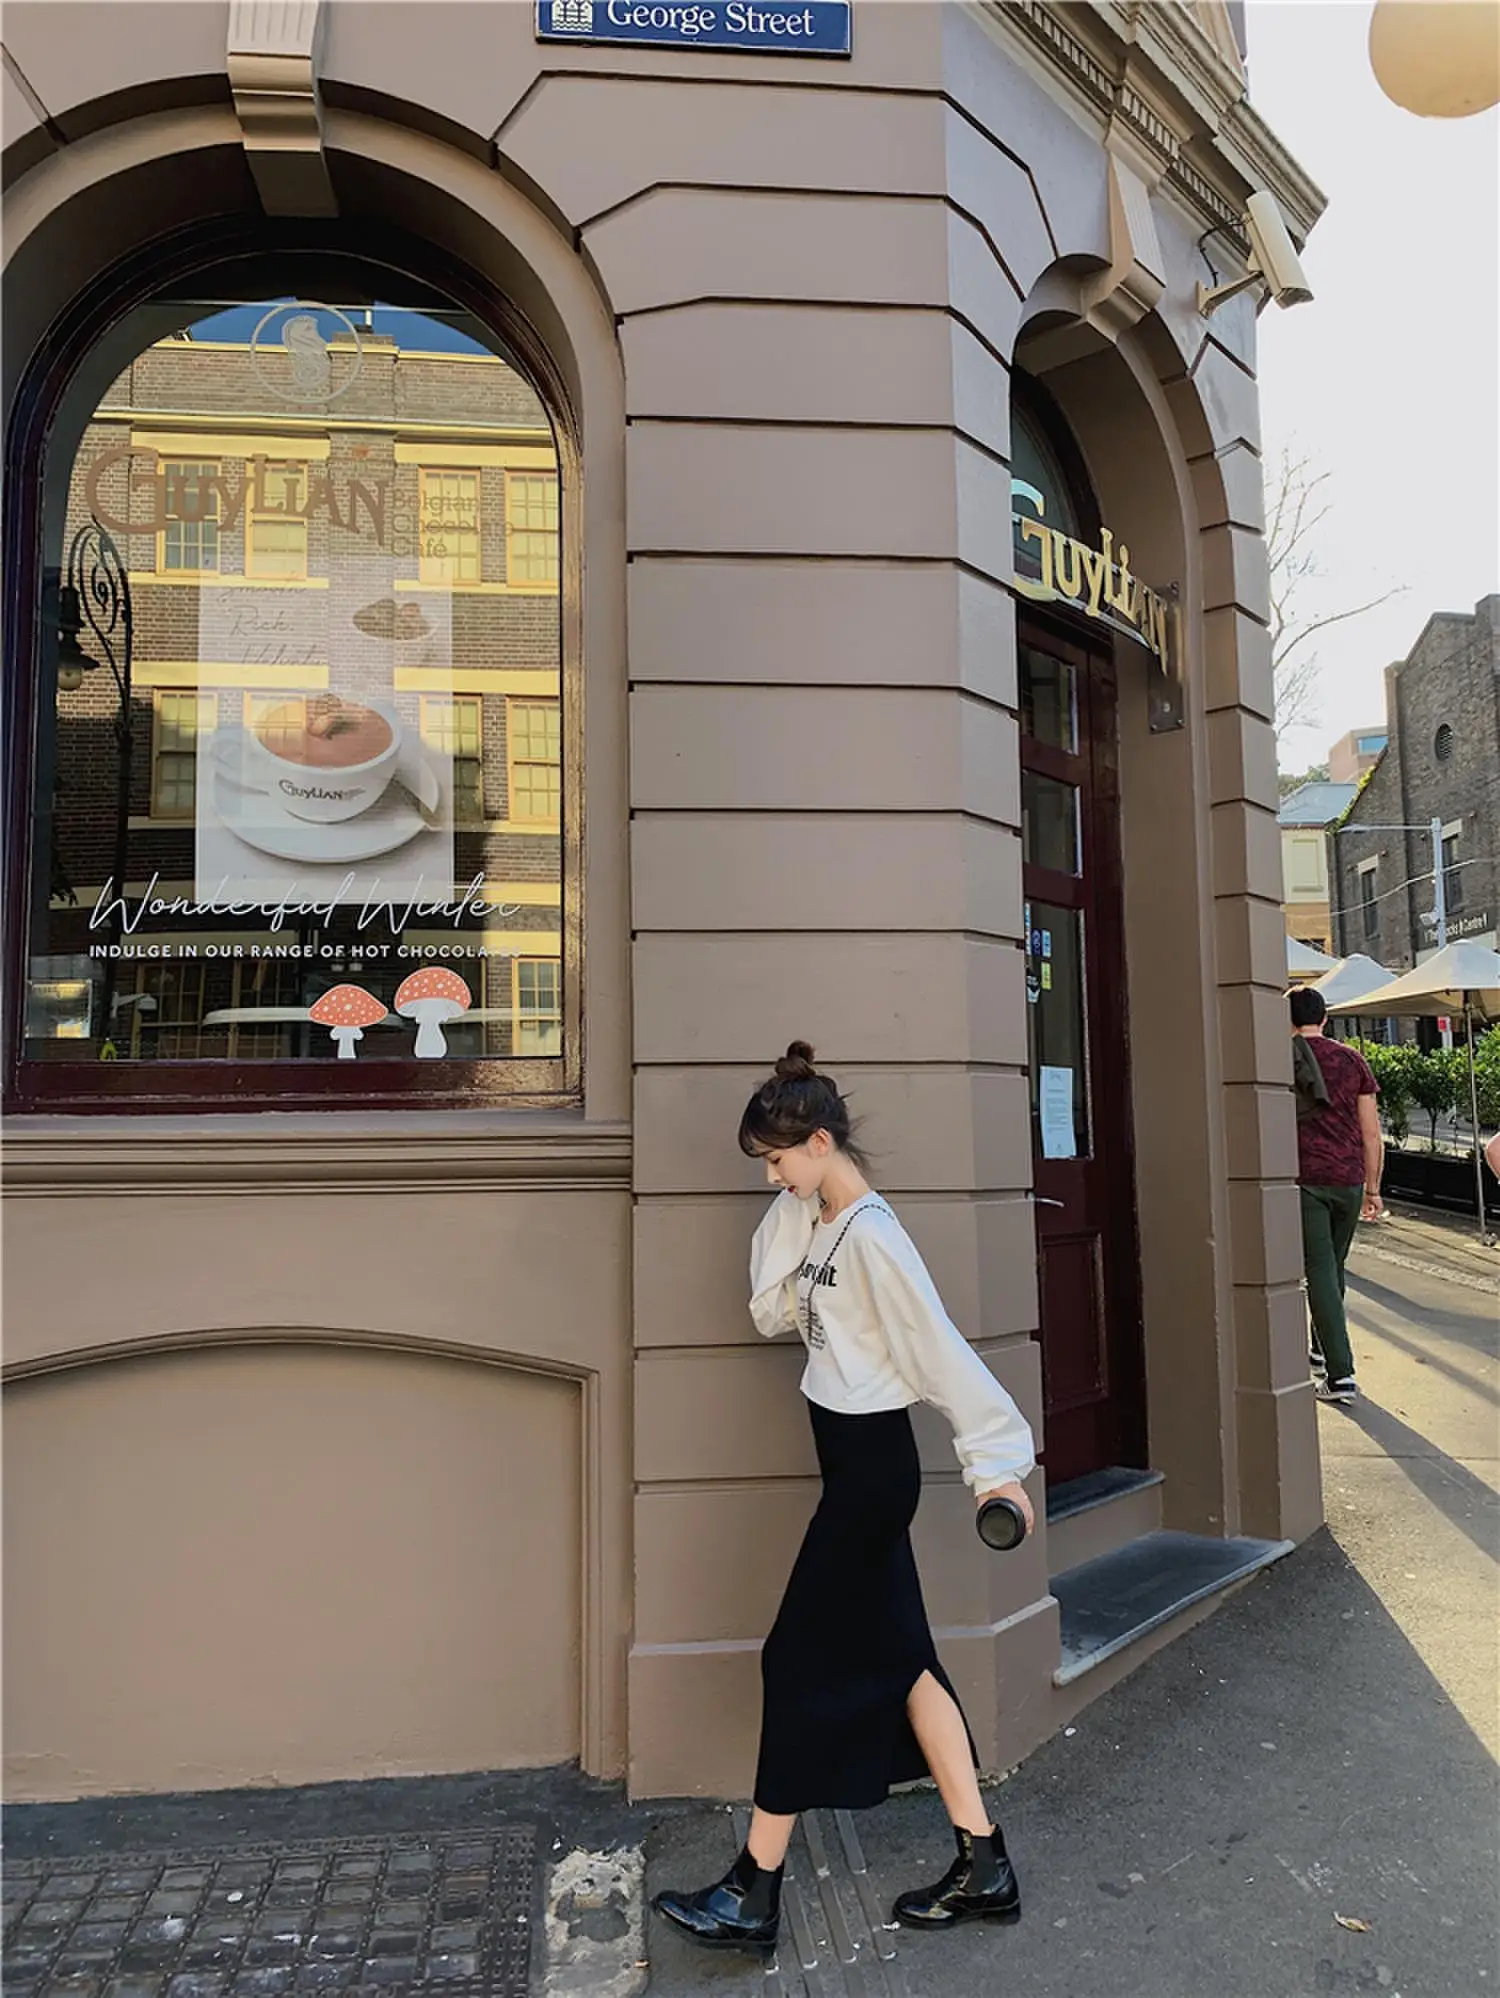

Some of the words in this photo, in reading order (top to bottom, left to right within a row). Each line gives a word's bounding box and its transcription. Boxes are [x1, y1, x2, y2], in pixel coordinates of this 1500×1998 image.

[607, 0, 716, 34] George
[725, 2, 815, 36] Street
[89, 871, 356, 934] Wonderful
[357, 871, 521, 935] Winter
[89, 944, 172, 957] INDULGE
[178, 944, 198, 957] IN
[205, 944, 244, 957] OUR
[250, 944, 314, 958] RANGE
[319, 944, 345, 958] OF
[351, 944, 391, 958] HOT
